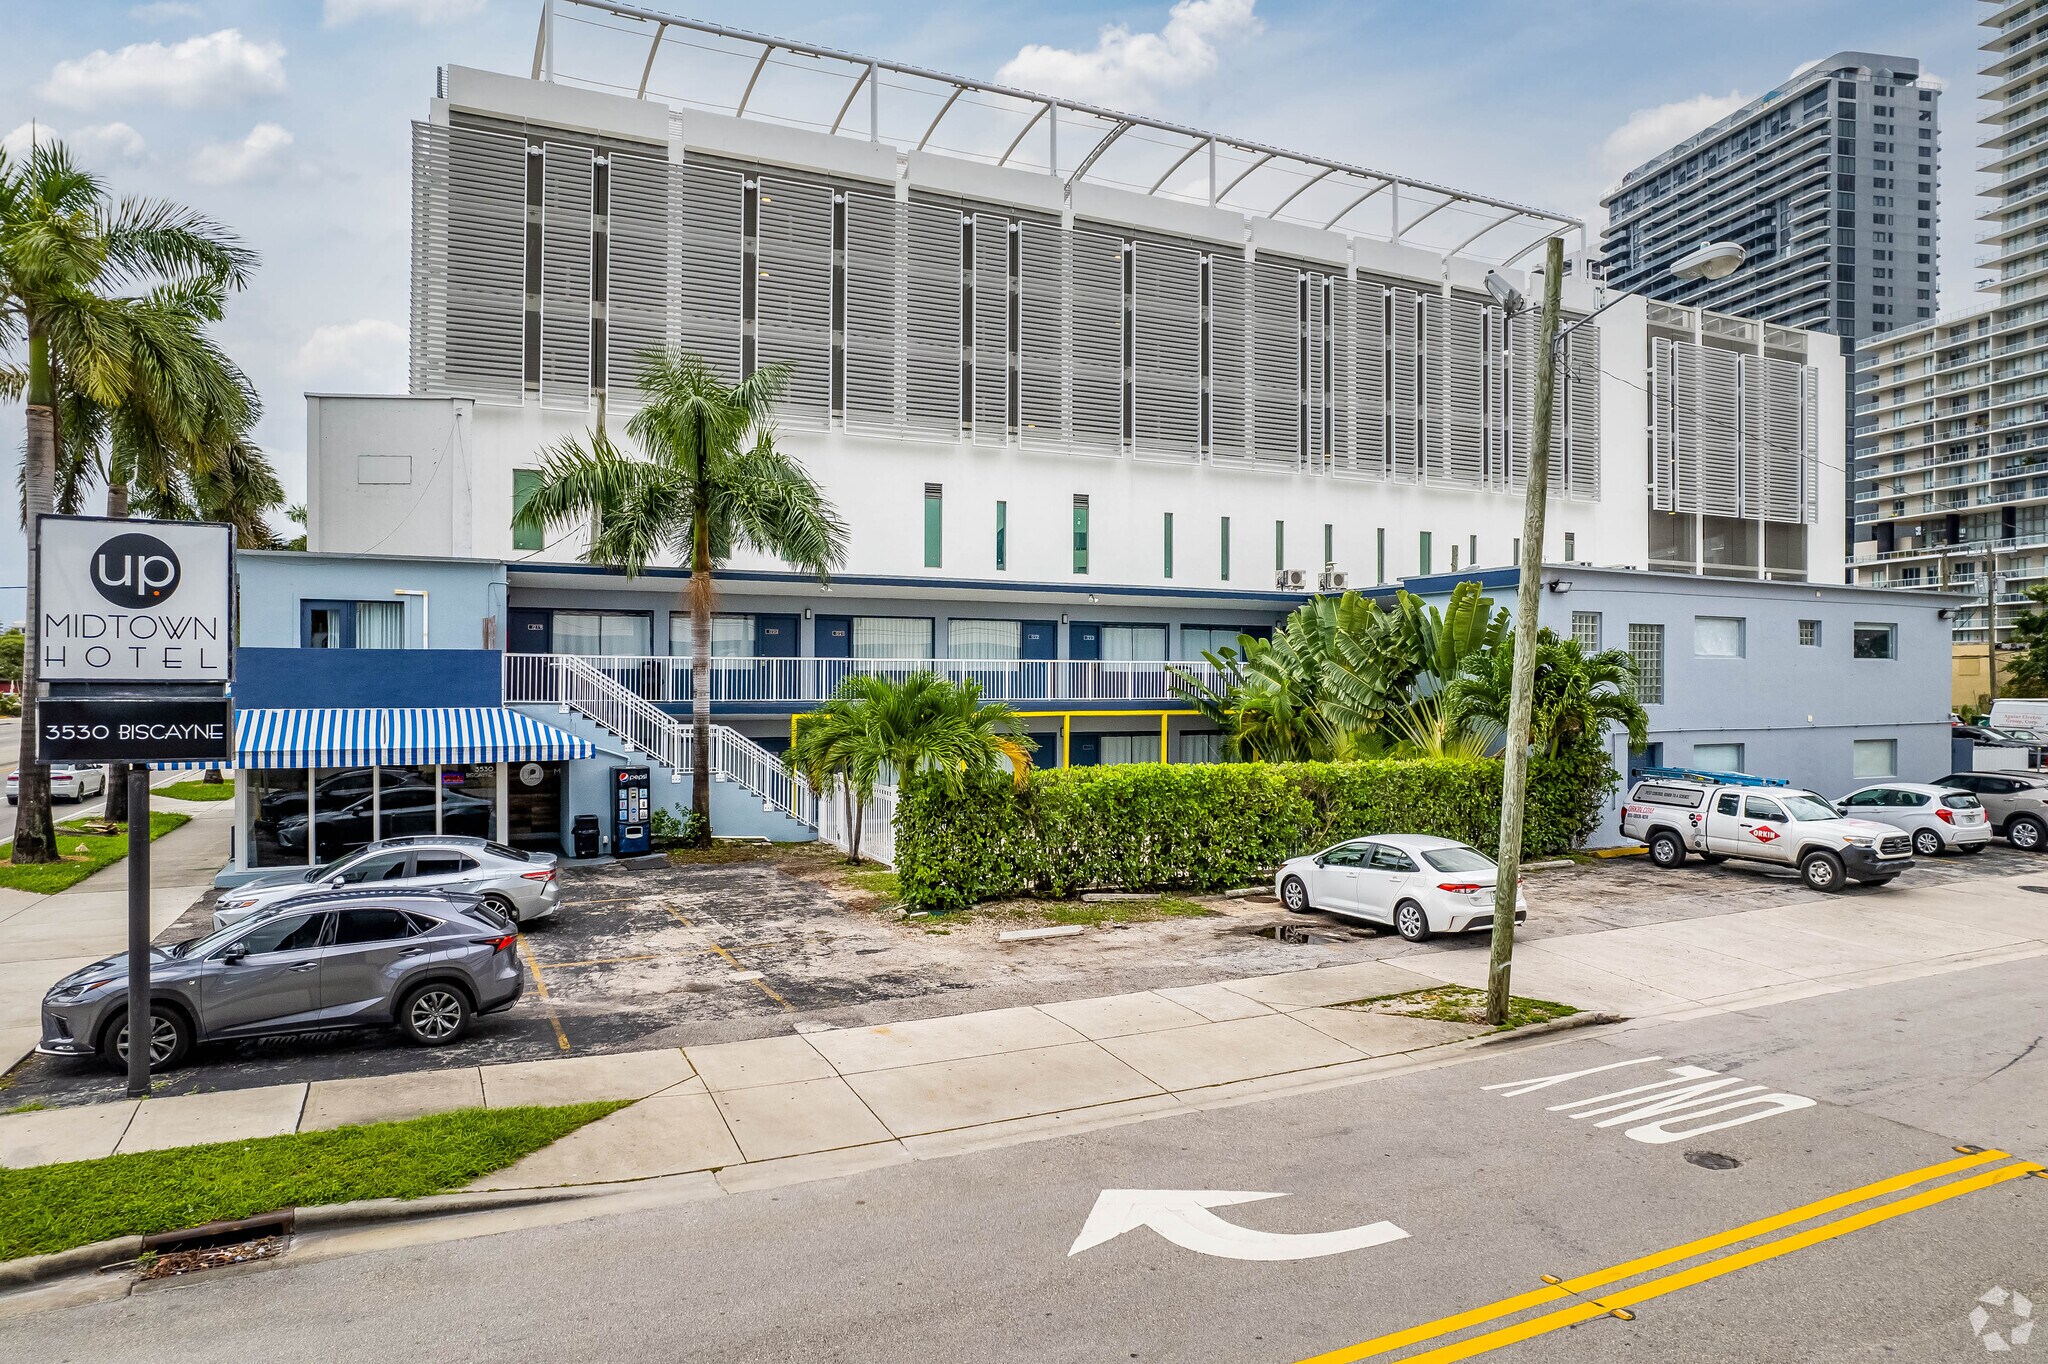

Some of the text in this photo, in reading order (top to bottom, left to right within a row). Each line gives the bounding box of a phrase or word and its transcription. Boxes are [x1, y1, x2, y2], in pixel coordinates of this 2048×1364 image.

[45, 613, 217, 641] MIDTOWN
[44, 645, 218, 669] HOTEL
[45, 723, 224, 740] 3530 BISCAYNE
[474, 765, 494, 773] 3530
[629, 773, 648, 781] pepsi
[1753, 829, 1776, 839] ORKIN
